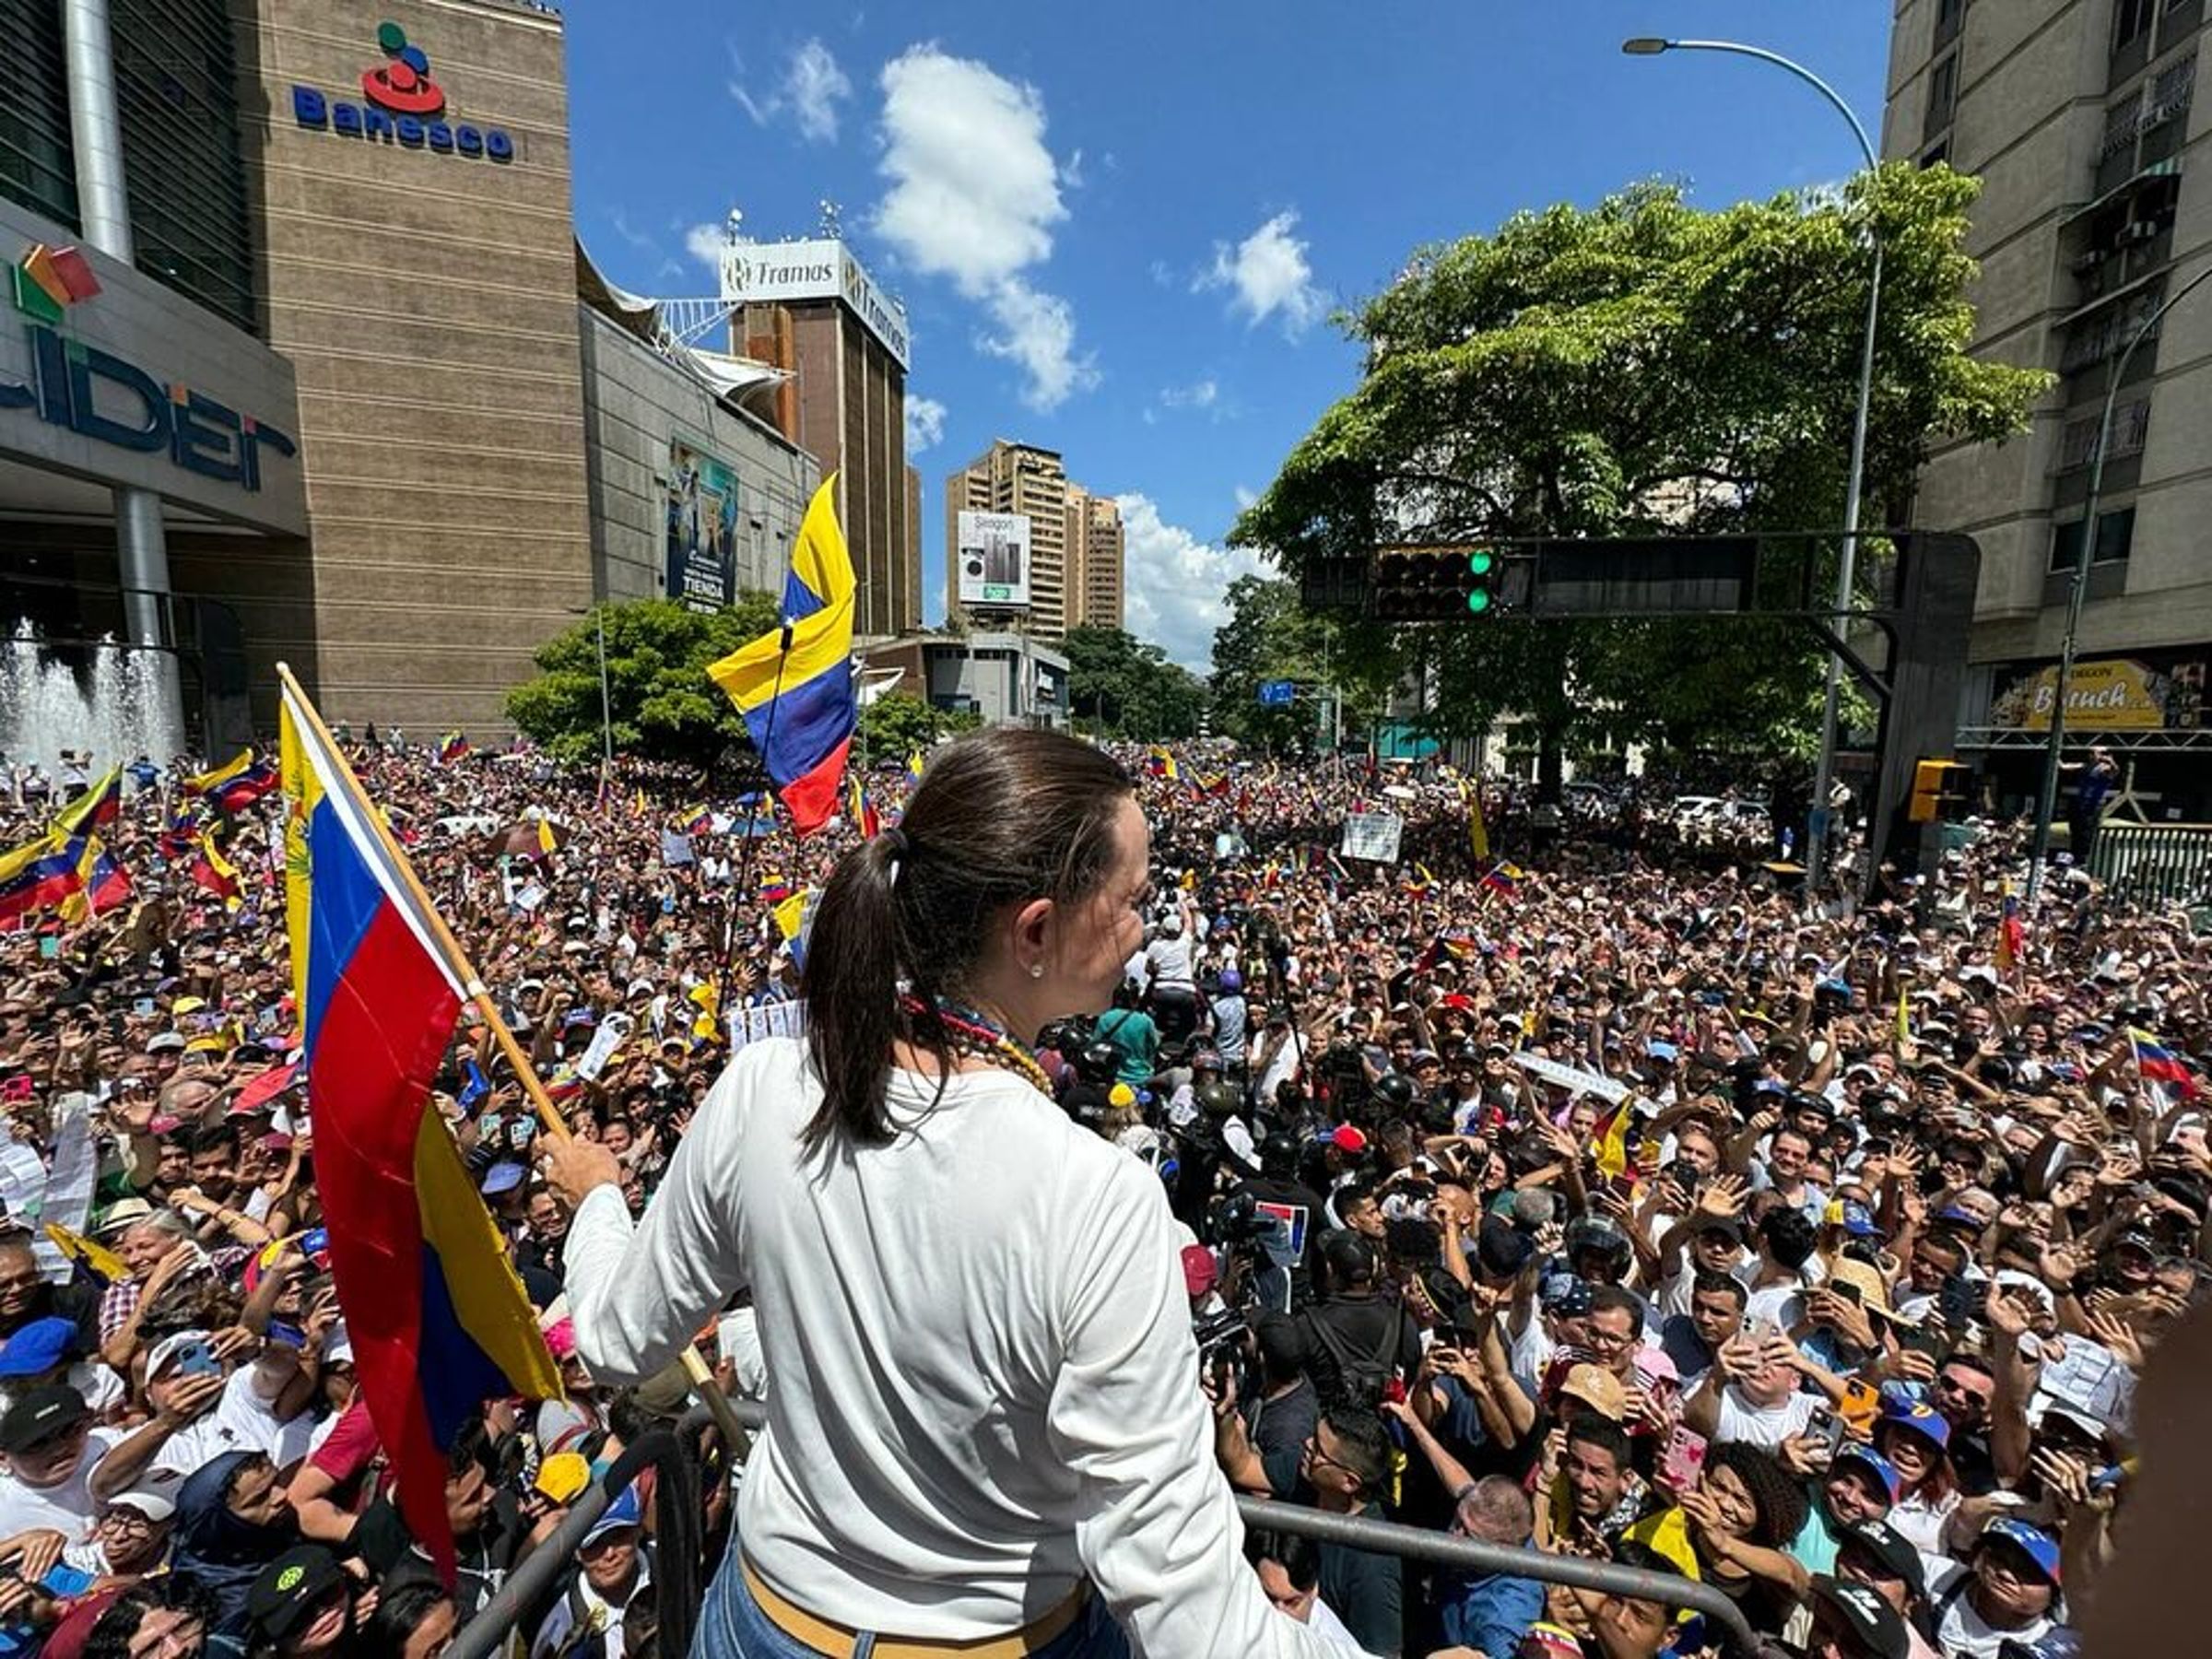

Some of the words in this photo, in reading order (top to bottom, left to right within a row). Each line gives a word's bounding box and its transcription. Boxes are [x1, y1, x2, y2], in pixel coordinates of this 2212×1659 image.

[292, 84, 513, 164] Banesco
[757, 262, 833, 286] Tramas
[2034, 680, 2127, 713] Bruch
